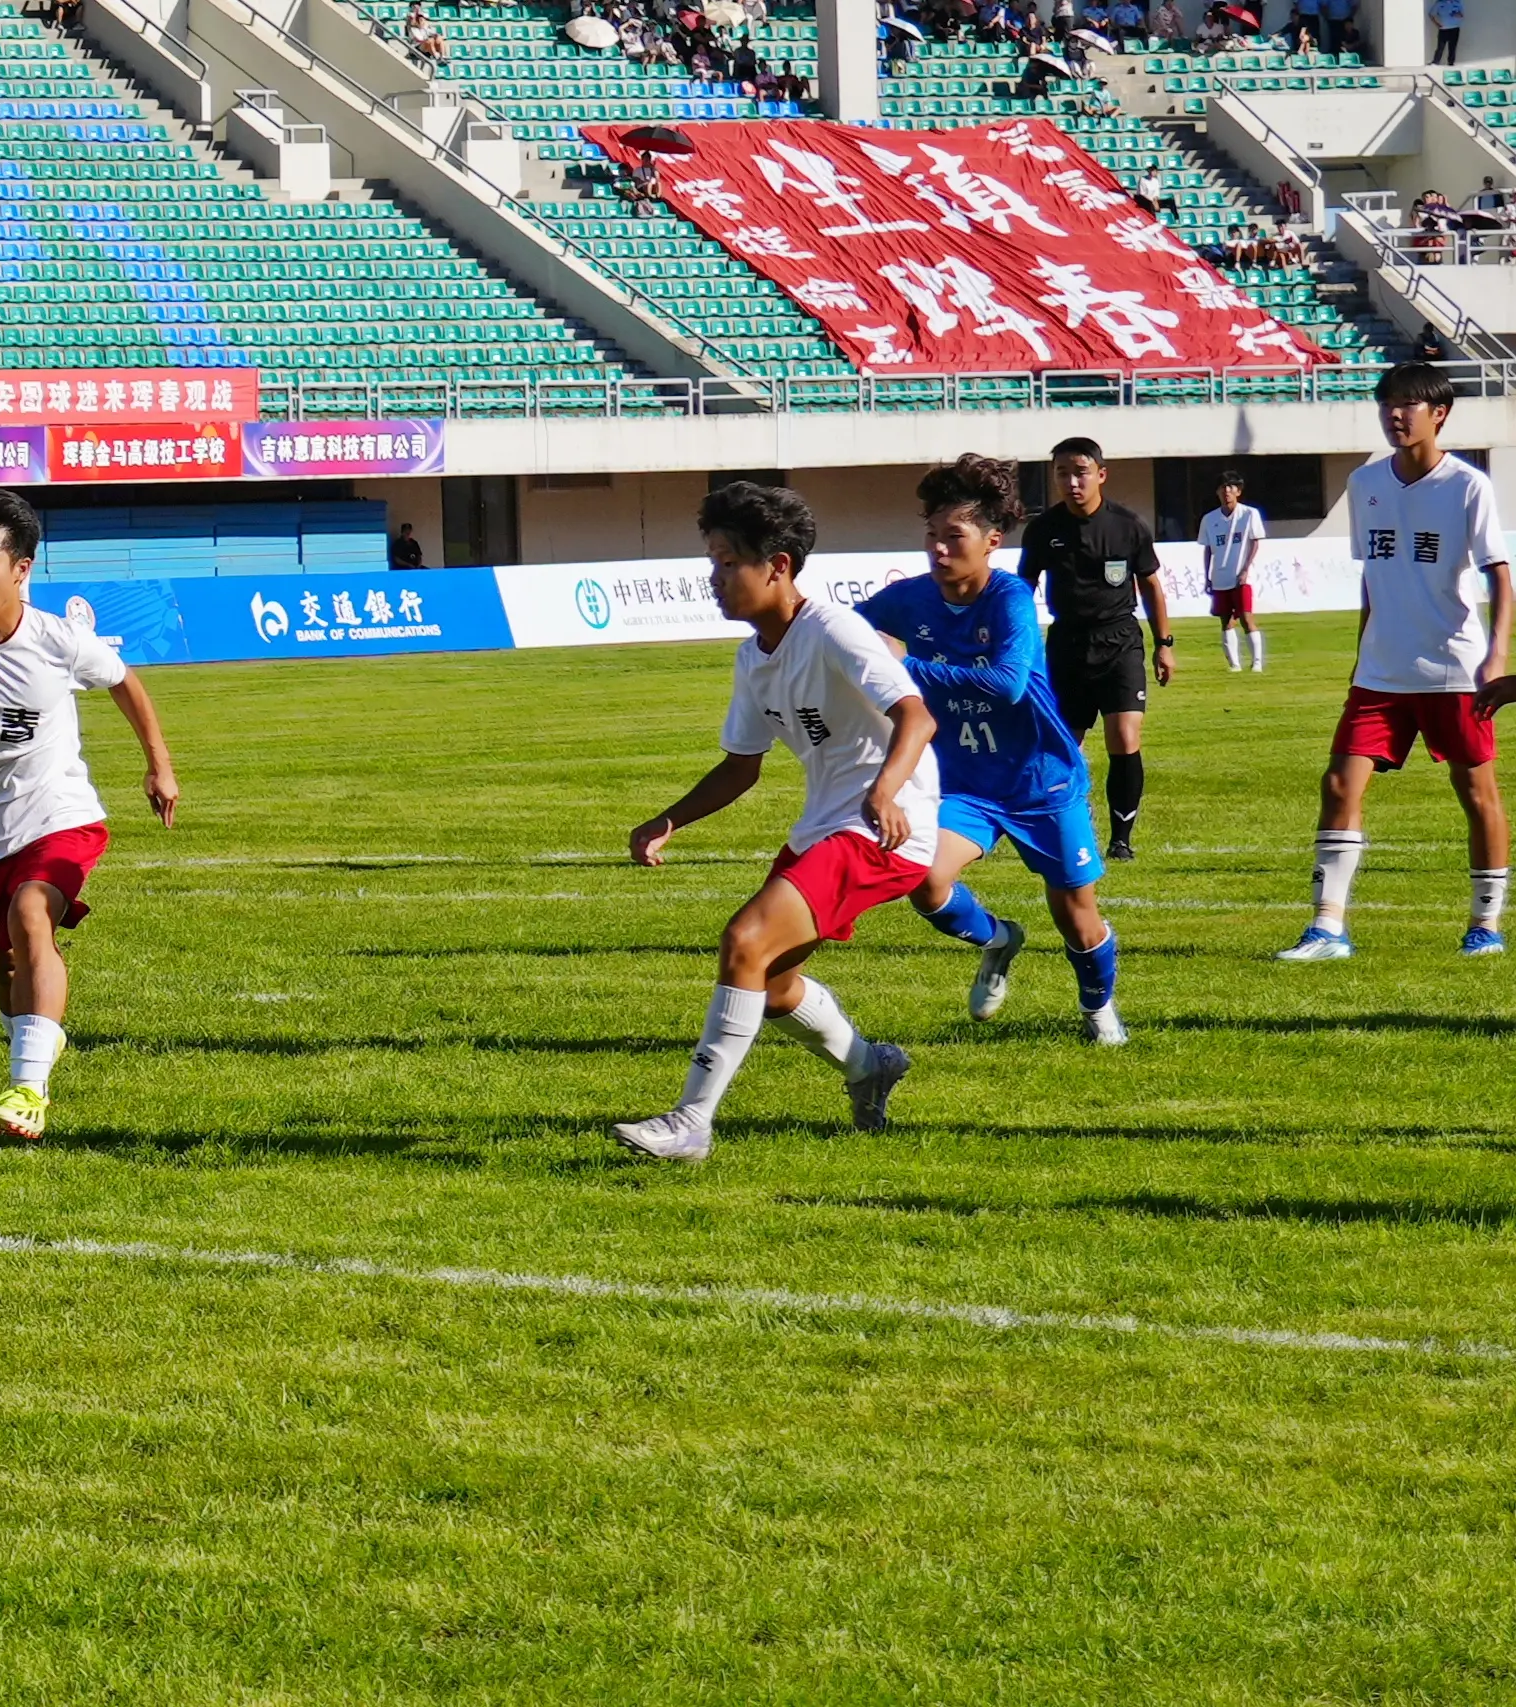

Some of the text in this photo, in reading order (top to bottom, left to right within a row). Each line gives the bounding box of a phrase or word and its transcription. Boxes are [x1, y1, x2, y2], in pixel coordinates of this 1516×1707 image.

[877, 254, 1183, 361] 珲春
[62, 438, 225, 468] 珲春金马高级技工学校
[1368, 529, 1441, 564] 珲春
[826, 580, 875, 603] ICBC
[295, 624, 442, 642] BANK OF COMMUNICATIONS
[959, 721, 998, 754] 41
